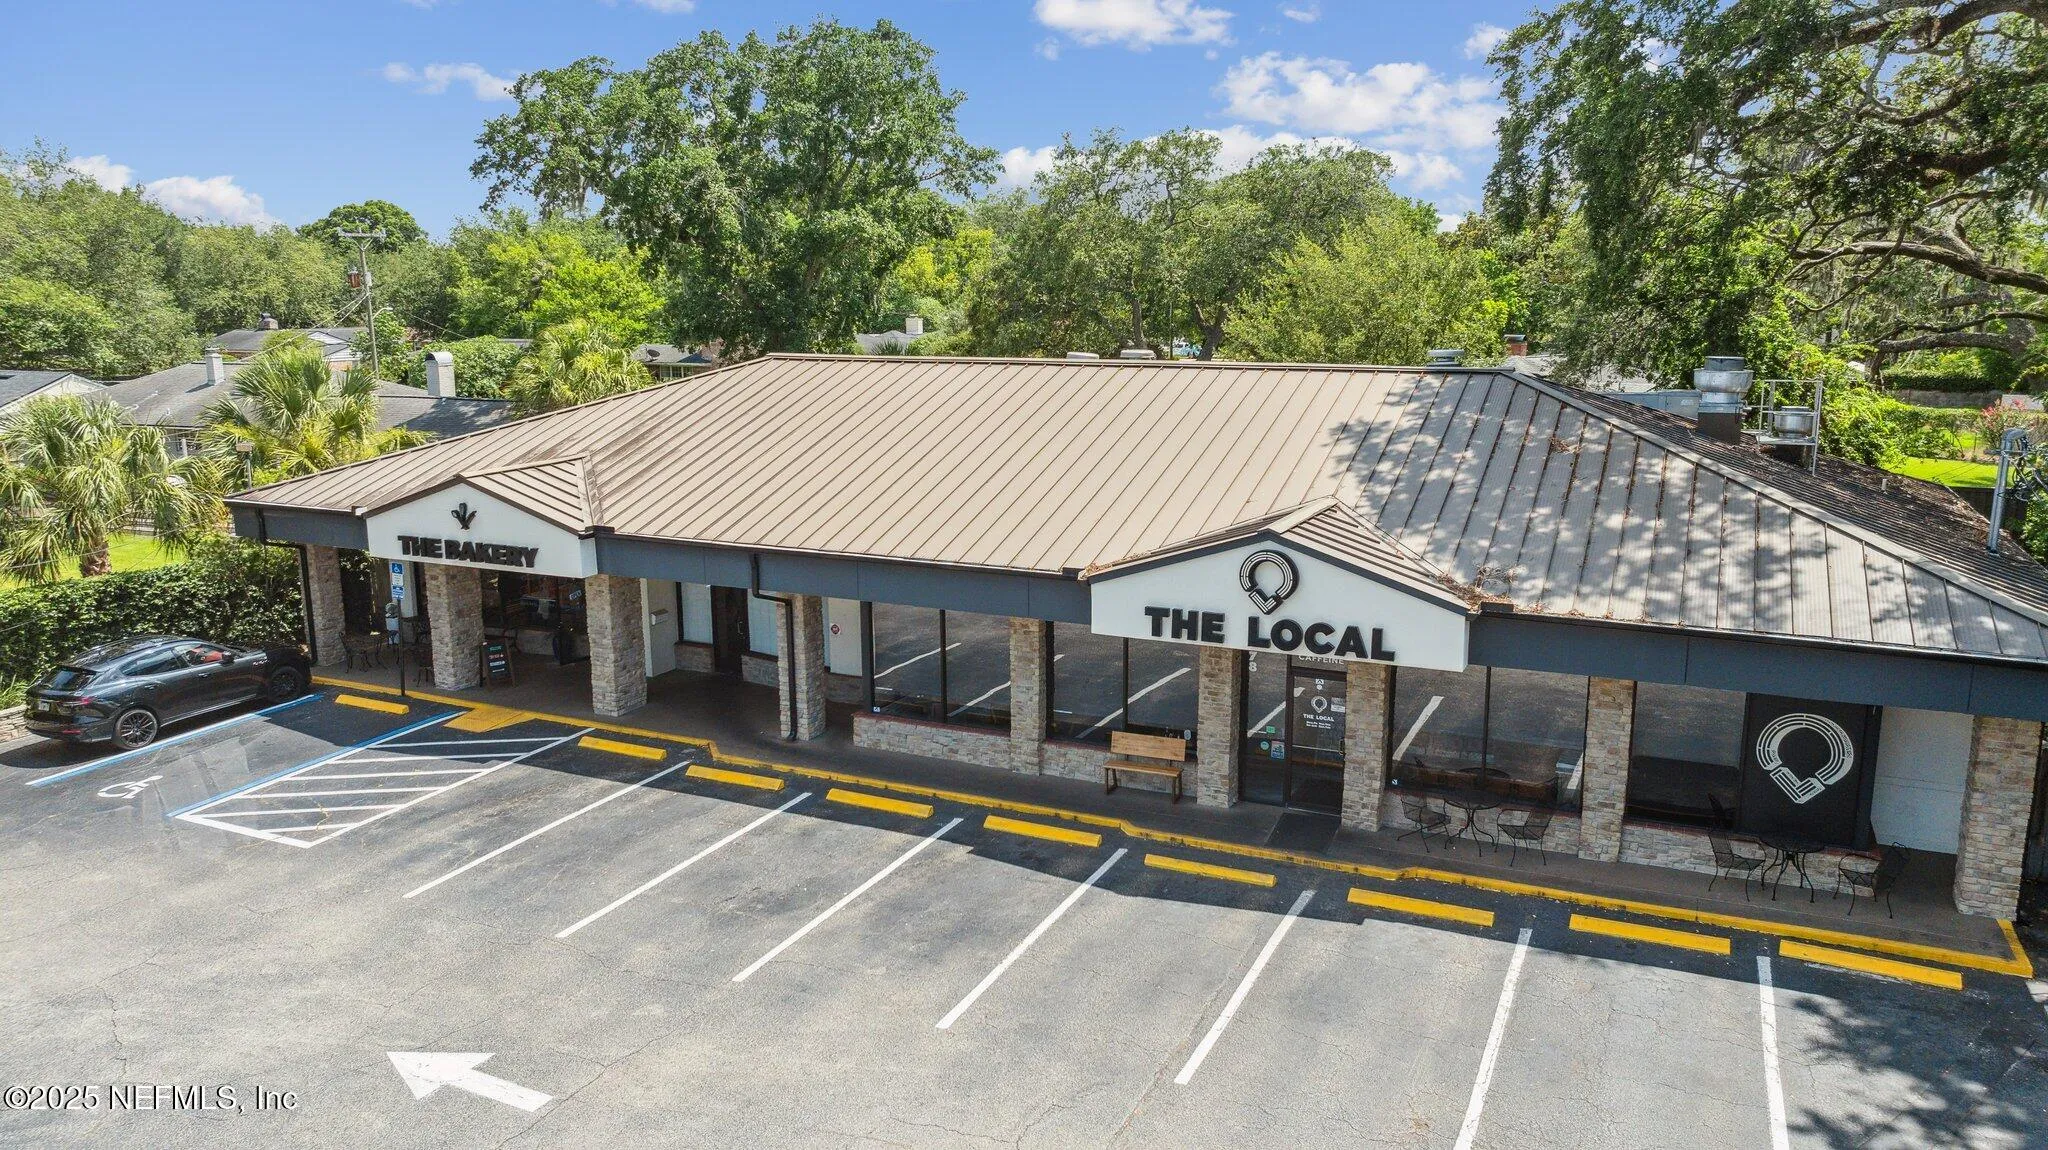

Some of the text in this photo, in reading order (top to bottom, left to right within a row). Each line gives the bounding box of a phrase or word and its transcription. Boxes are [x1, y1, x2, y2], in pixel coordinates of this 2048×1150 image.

[397, 535, 540, 568] THE BAKERY
[1145, 606, 1395, 662] THE LOCAL
[1298, 655, 1345, 665] CAFFEINE
